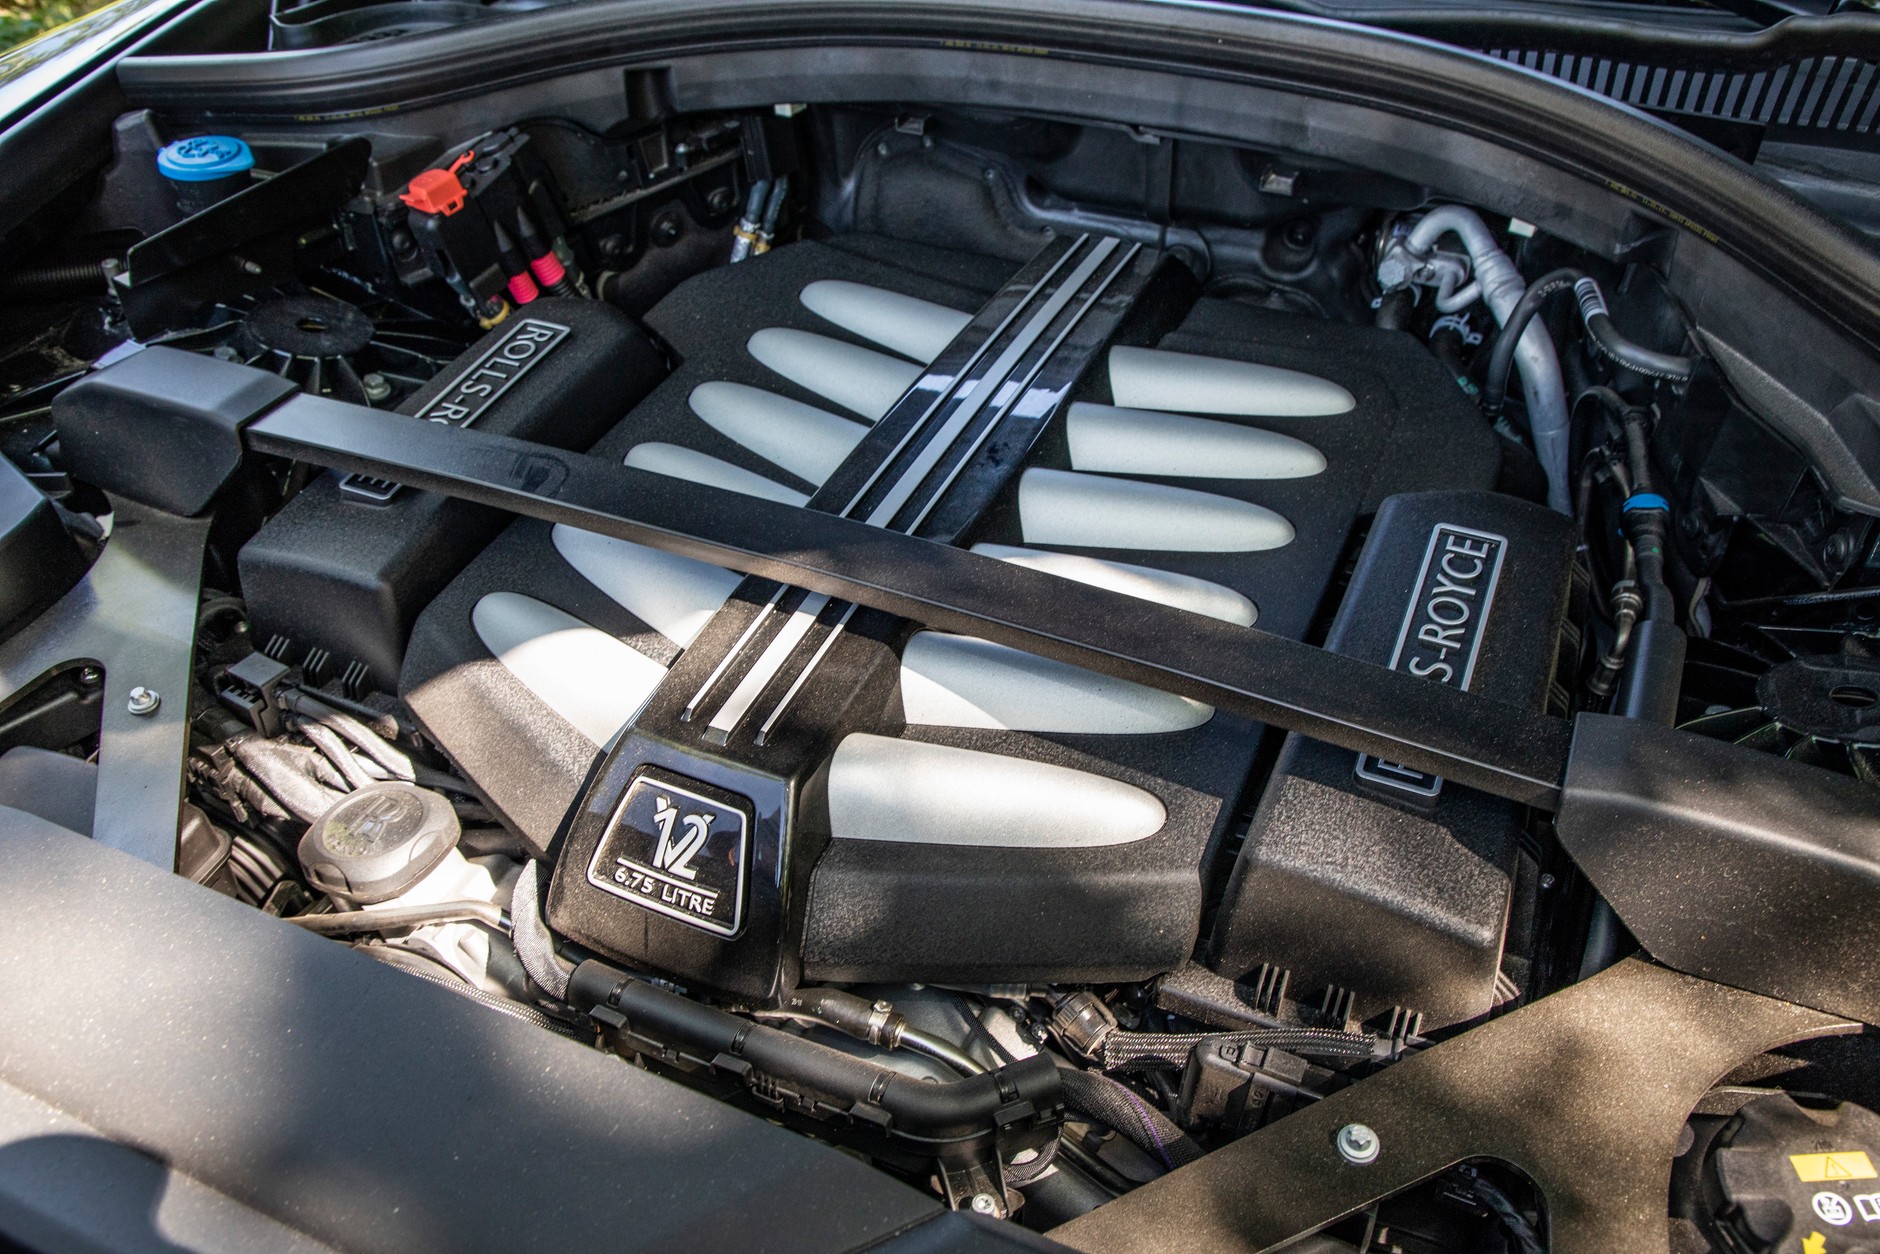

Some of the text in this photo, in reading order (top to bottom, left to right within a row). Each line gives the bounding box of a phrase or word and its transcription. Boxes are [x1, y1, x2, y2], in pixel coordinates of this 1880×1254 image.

[429, 326, 554, 425] ROLLS-R
[1408, 534, 1490, 684] S-ROYCE
[614, 866, 715, 916] 6.75 LITRE
